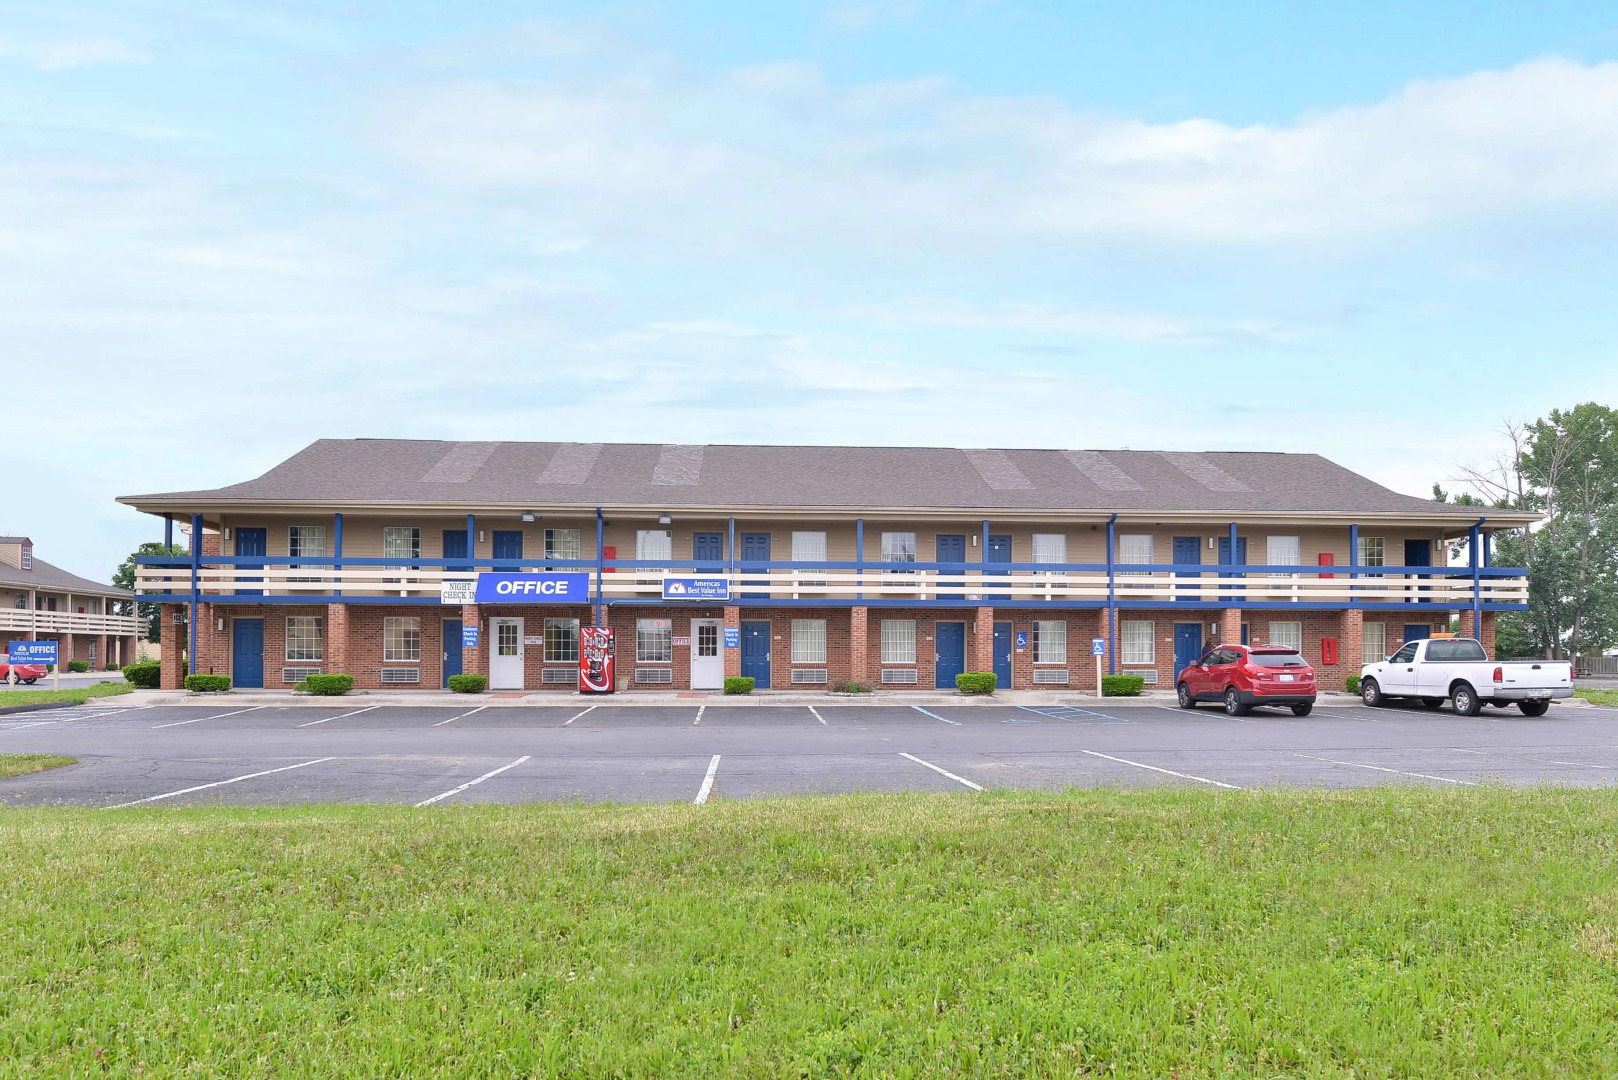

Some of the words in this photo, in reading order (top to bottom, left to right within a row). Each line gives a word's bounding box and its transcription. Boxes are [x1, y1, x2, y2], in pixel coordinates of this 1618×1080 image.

[449, 582, 472, 592] NIGHT
[496, 580, 569, 595] OFFICE
[687, 586, 700, 594] Best
[700, 586, 716, 594] Value
[716, 586, 727, 594] Inn
[443, 591, 467, 600] CHECK
[29, 645, 56, 654] OFFICE
